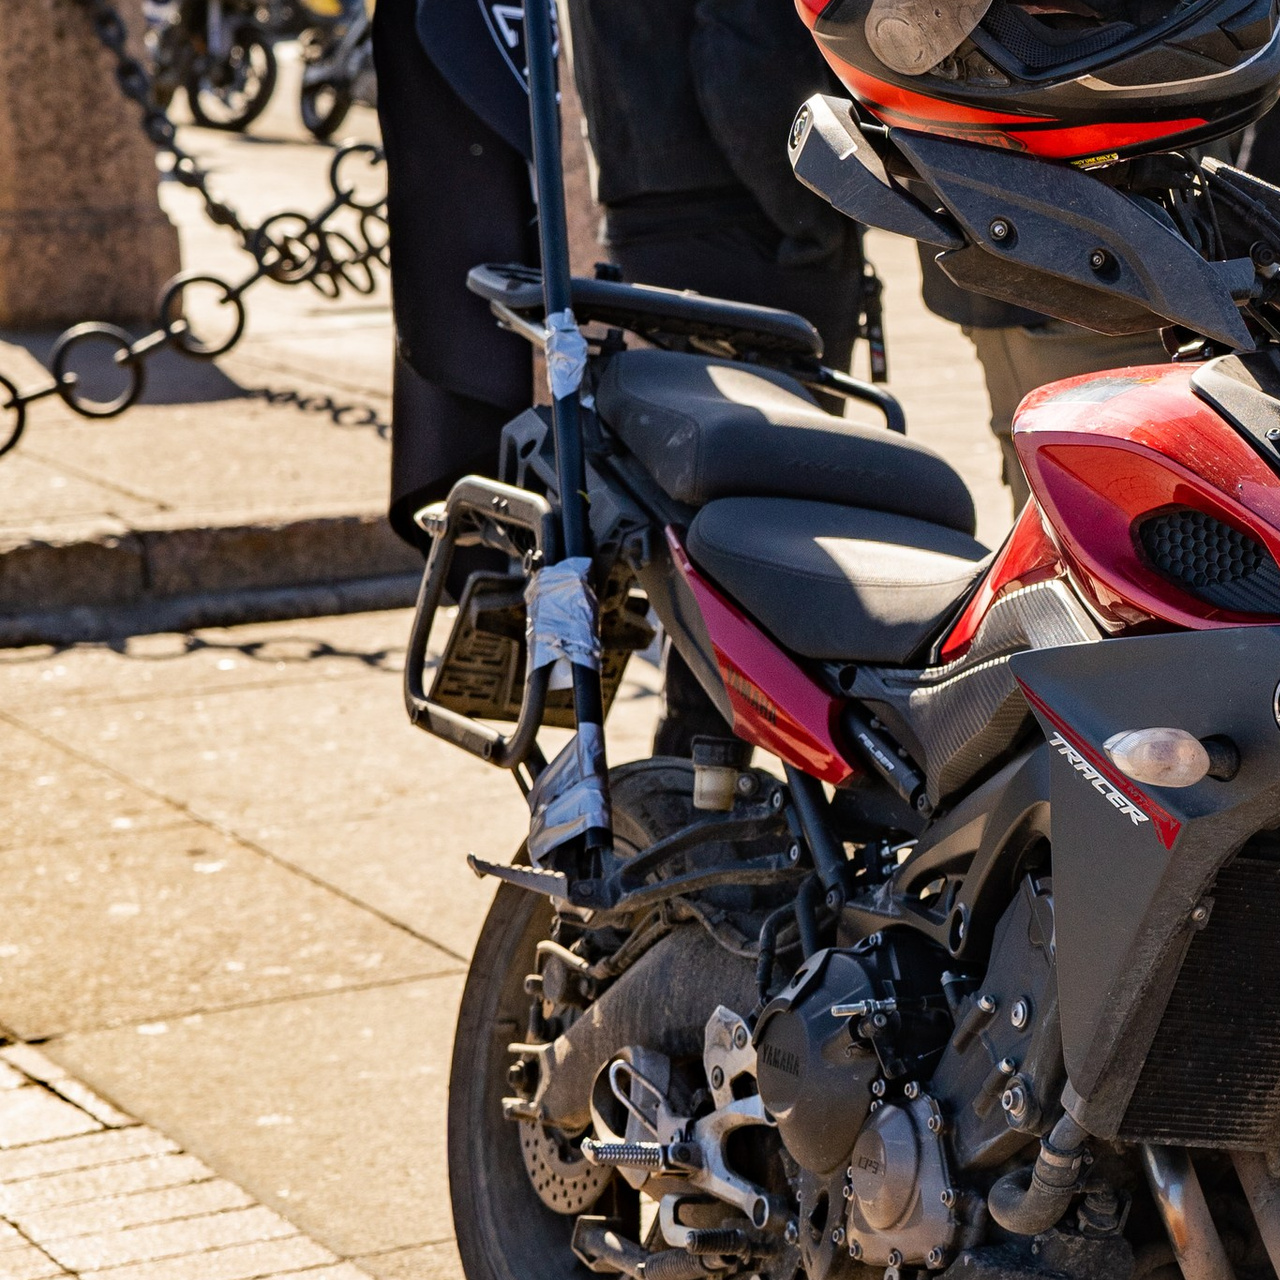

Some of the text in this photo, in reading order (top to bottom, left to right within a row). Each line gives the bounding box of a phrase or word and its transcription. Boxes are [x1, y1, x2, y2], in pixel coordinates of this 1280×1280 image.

[726, 662, 777, 727] YAMAHA
[1049, 731, 1149, 826] TRACER
[763, 1043, 799, 1076] YAMAHA
